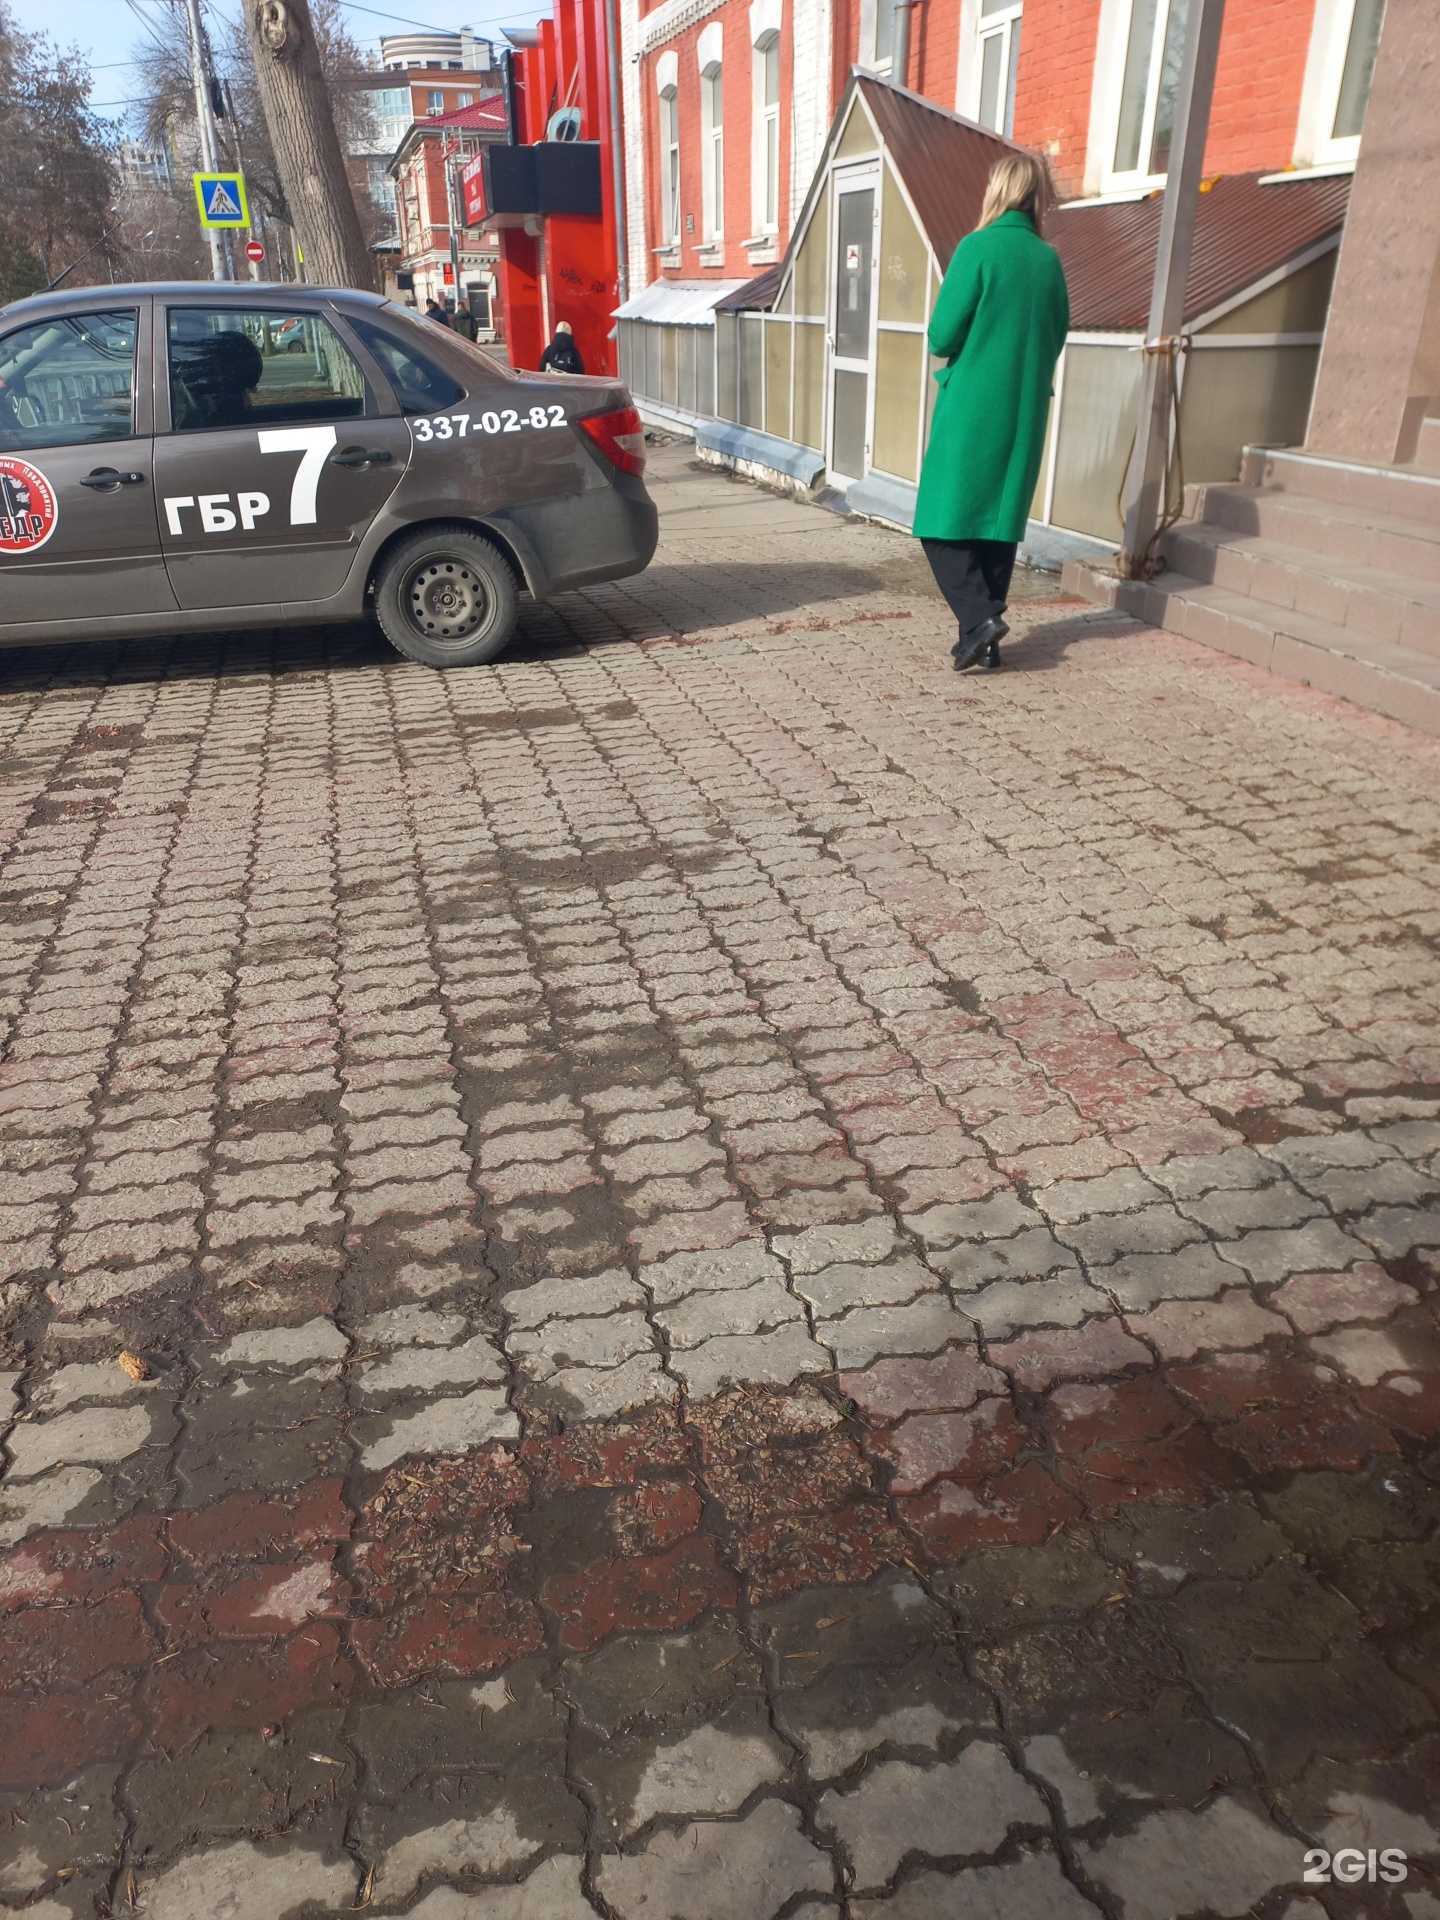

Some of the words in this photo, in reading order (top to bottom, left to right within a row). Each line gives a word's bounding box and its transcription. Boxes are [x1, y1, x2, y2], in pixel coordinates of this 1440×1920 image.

[413, 405, 568, 442] 337-02-82
[163, 491, 271, 536] ГБР
[257, 426, 338, 525] 7
